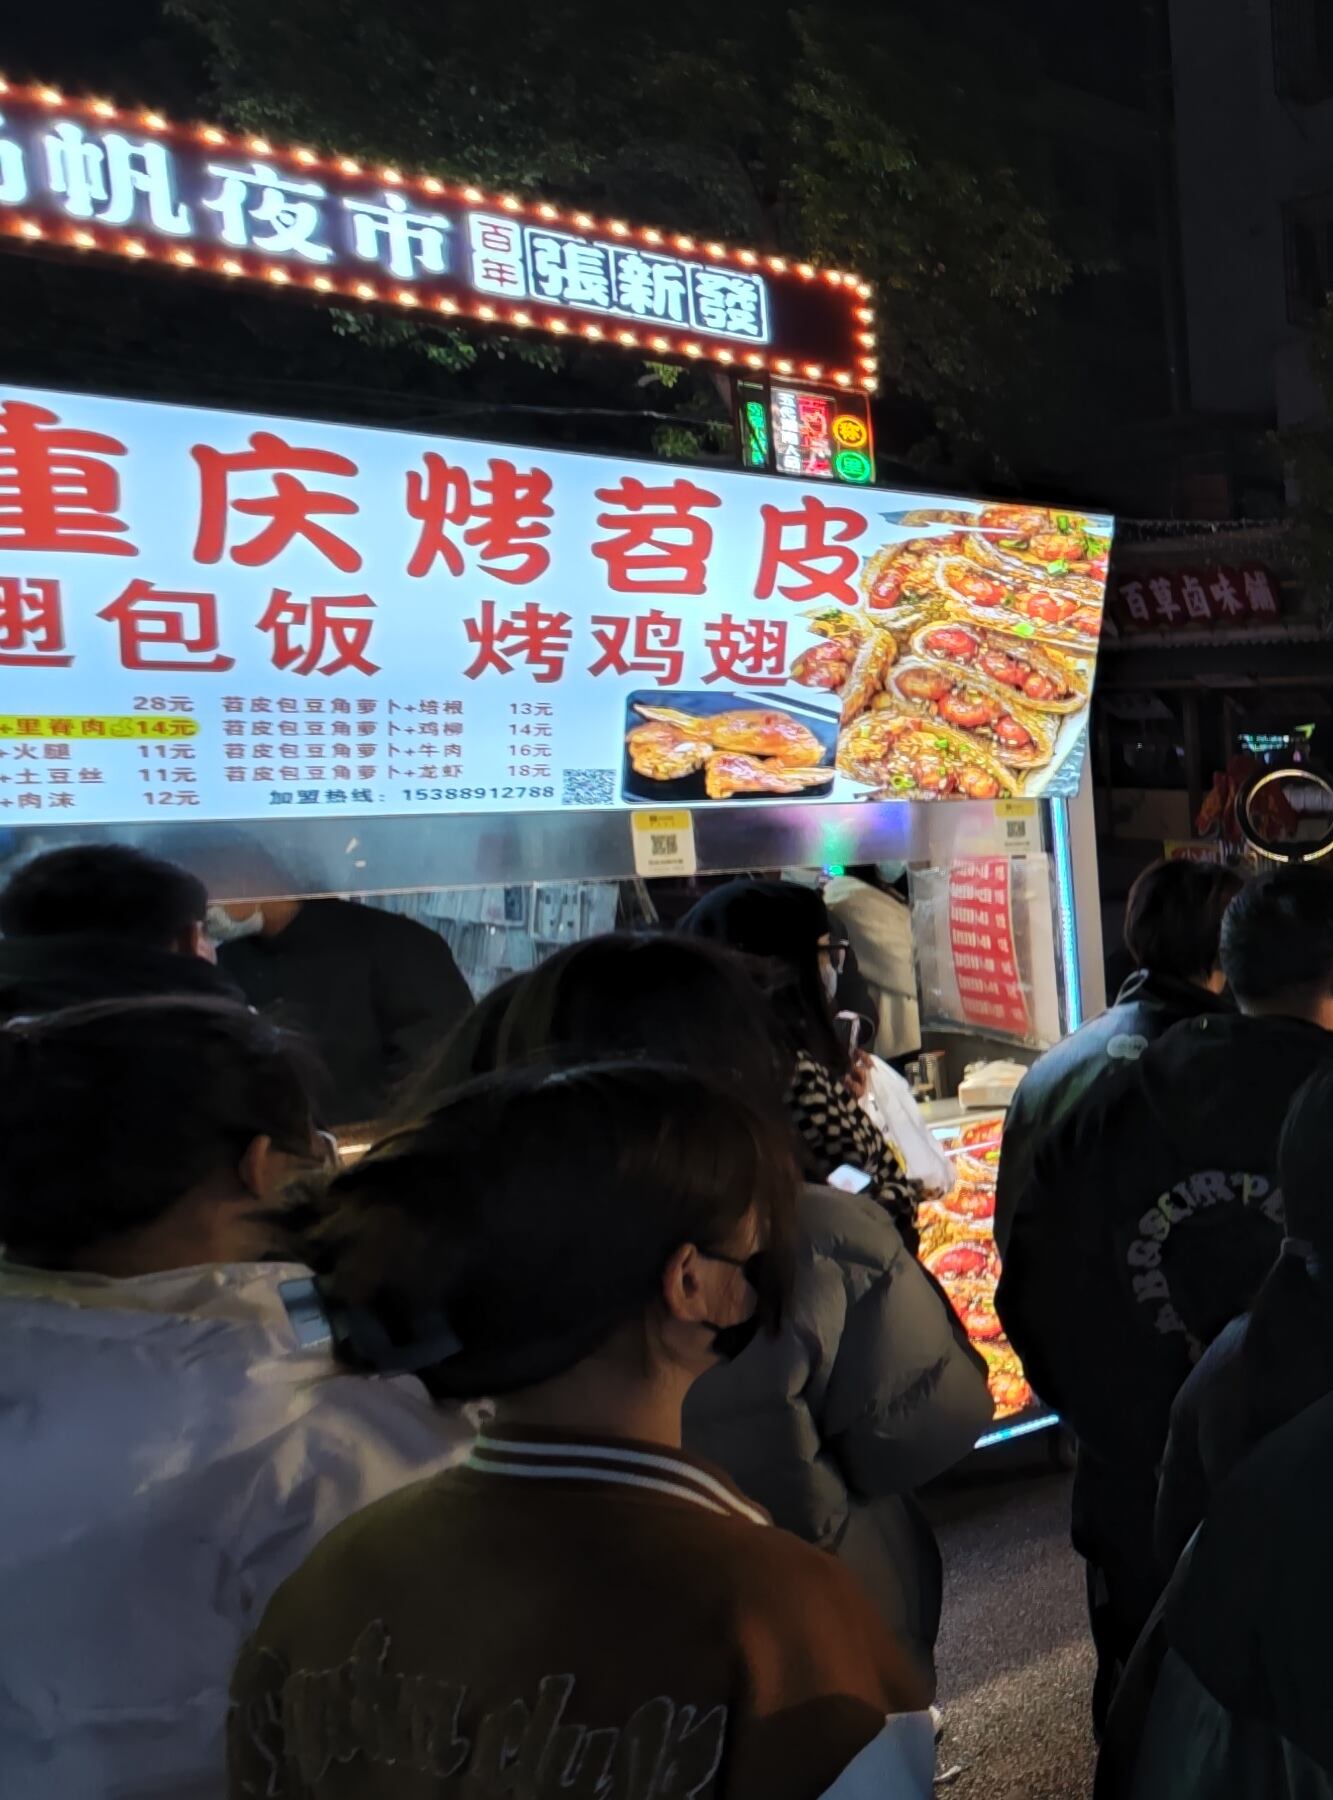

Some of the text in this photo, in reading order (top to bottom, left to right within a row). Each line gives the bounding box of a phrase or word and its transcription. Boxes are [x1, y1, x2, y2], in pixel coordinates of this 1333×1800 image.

[0, 114, 450, 278] 帆夜市
[477, 220, 519, 288] 百年
[531, 238, 760, 336] 張新發
[463, 600, 790, 687] 烤鸡翅
[132, 696, 194, 712] 28元
[509, 702, 554, 716] 13元
[136, 719, 195, 737] 14元
[509, 723, 553, 737] 14元
[137, 744, 196, 760] 11元
[509, 744, 553, 759] 16元
[138, 767, 197, 783] 11元
[507, 764, 552, 779] 18元
[143, 791, 201, 806] 12元
[402, 786, 555, 801] 15388912788
